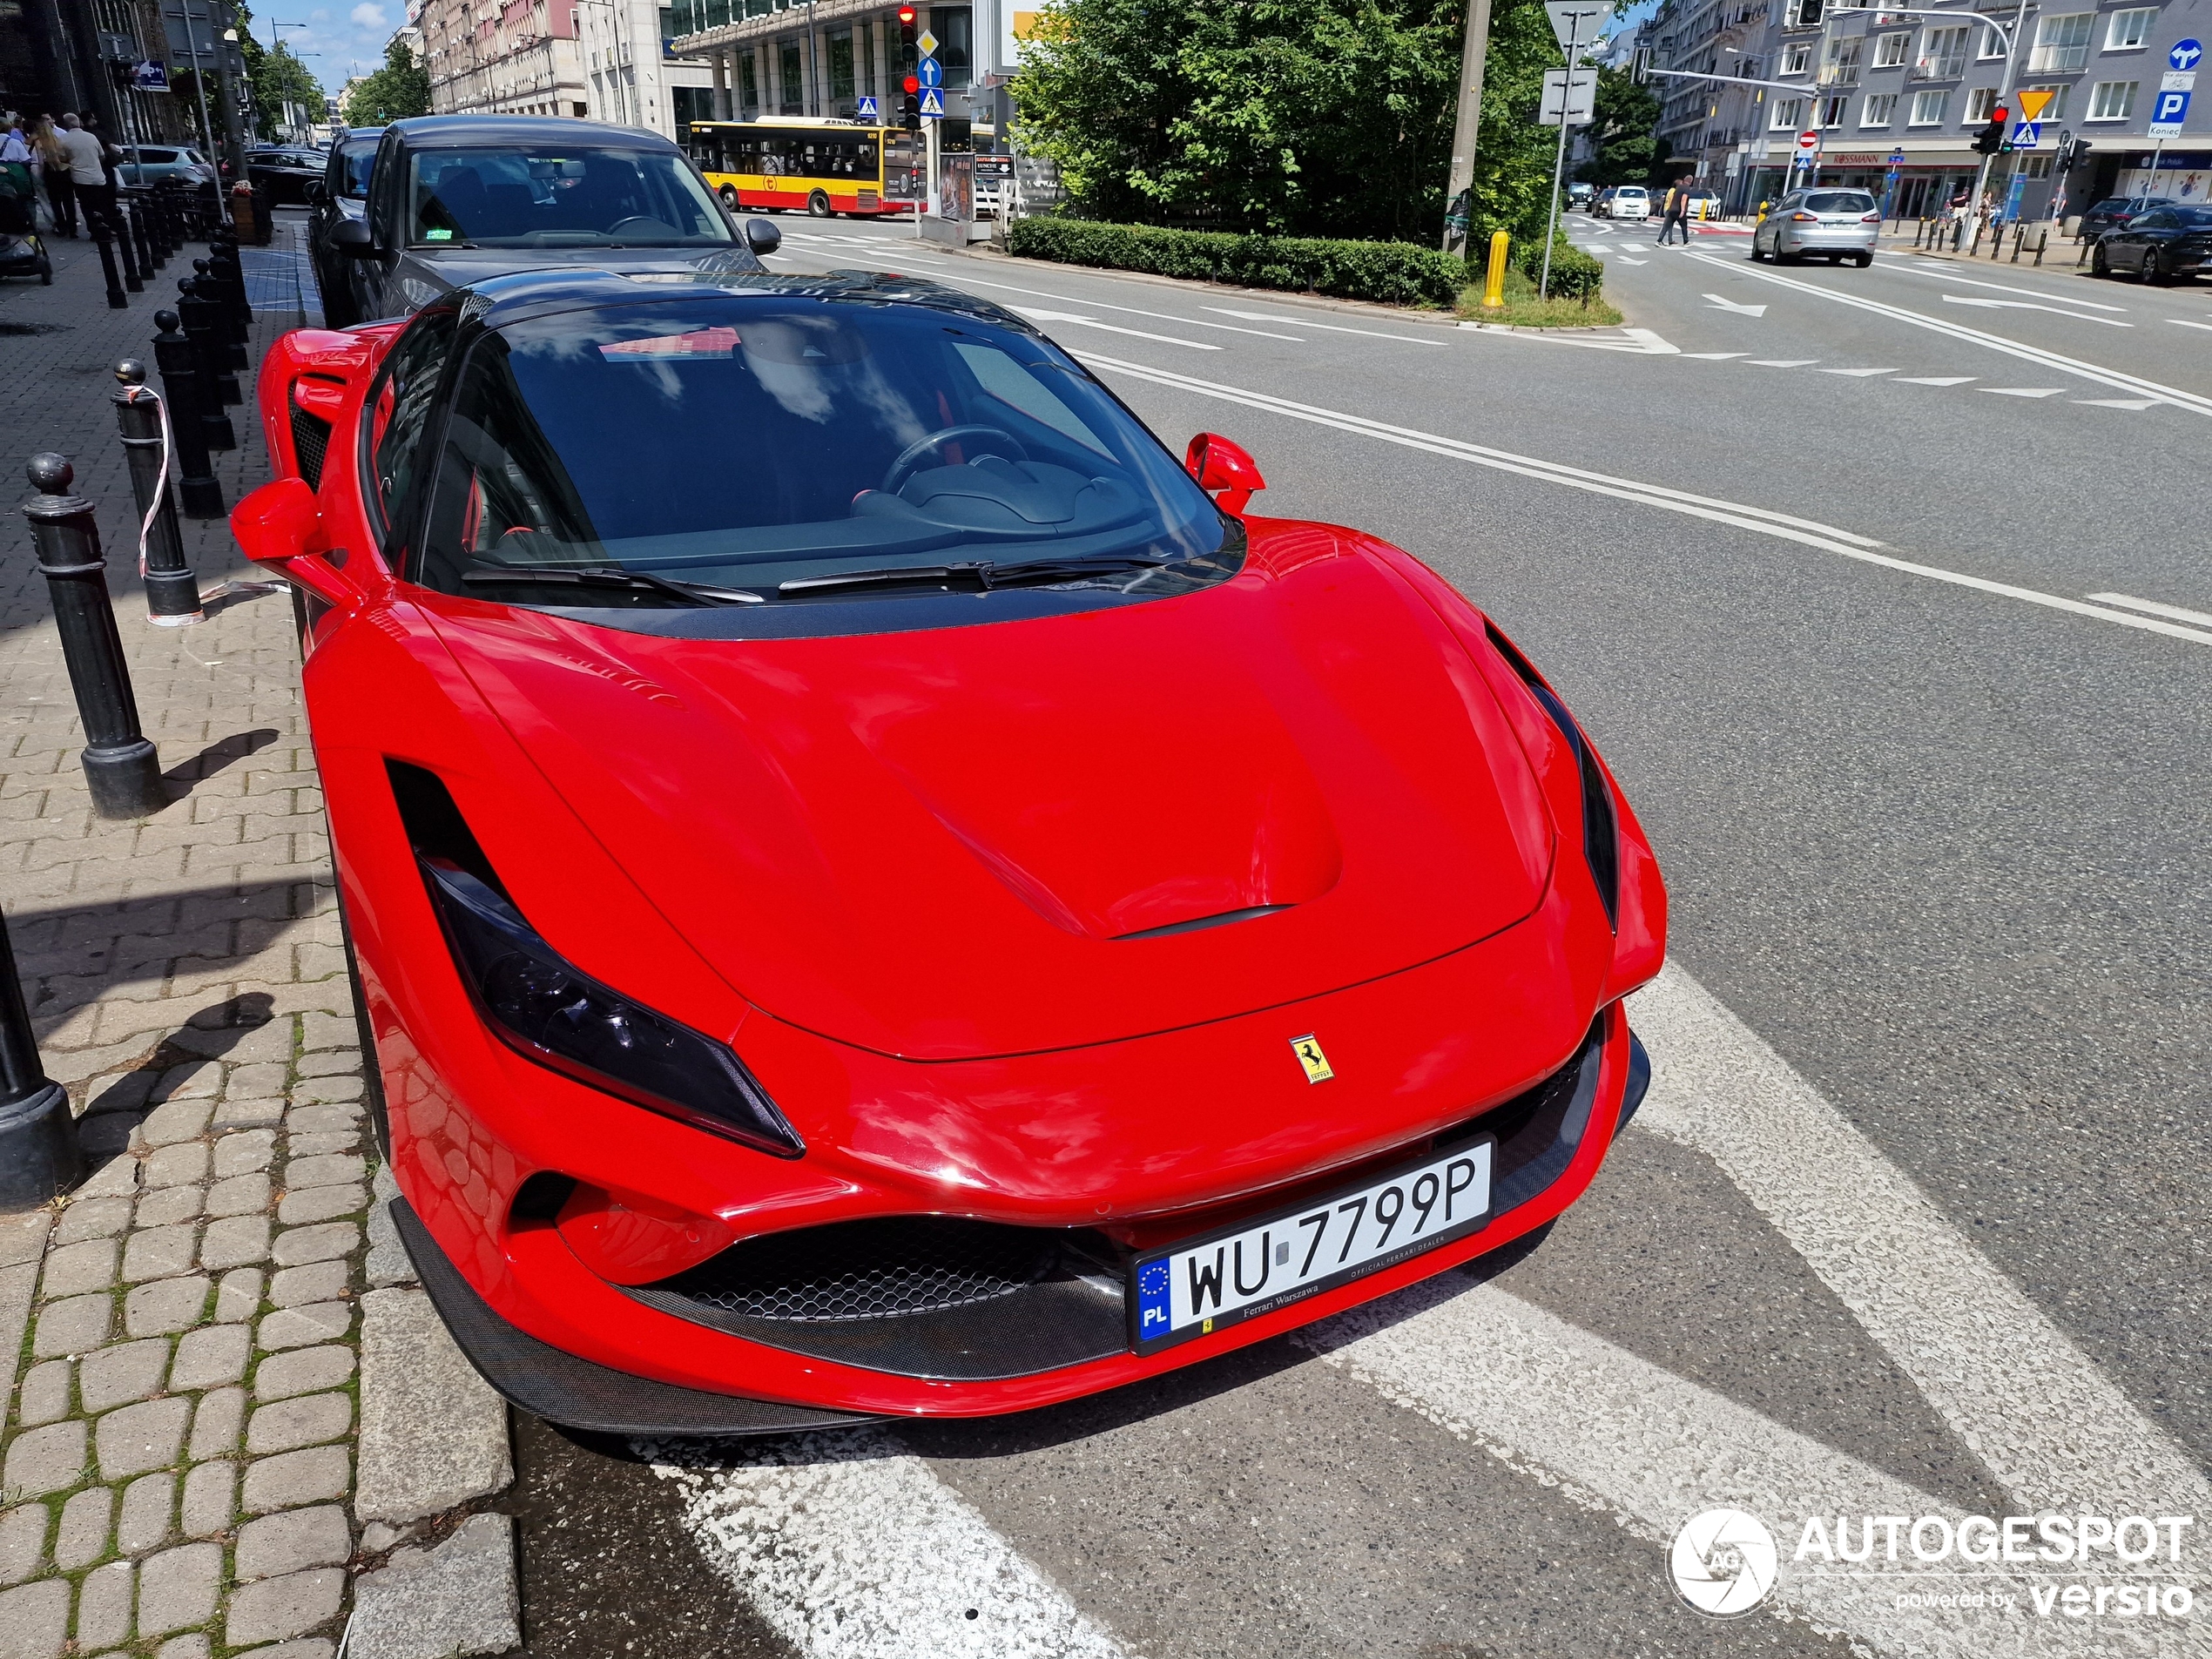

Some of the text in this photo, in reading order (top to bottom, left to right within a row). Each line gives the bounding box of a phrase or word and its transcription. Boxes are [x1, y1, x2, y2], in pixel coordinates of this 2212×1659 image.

[2159, 95, 2183, 120] P
[1833, 154, 1879, 165] ROSSMANN
[1188, 1158, 1476, 1317] WU 7799P
[1351, 1236, 1445, 1278] OFFICIAL FERRARI DEALER
[1143, 1305, 1167, 1327] PL
[1243, 1285, 1318, 1318] Ferrari Warszawa
